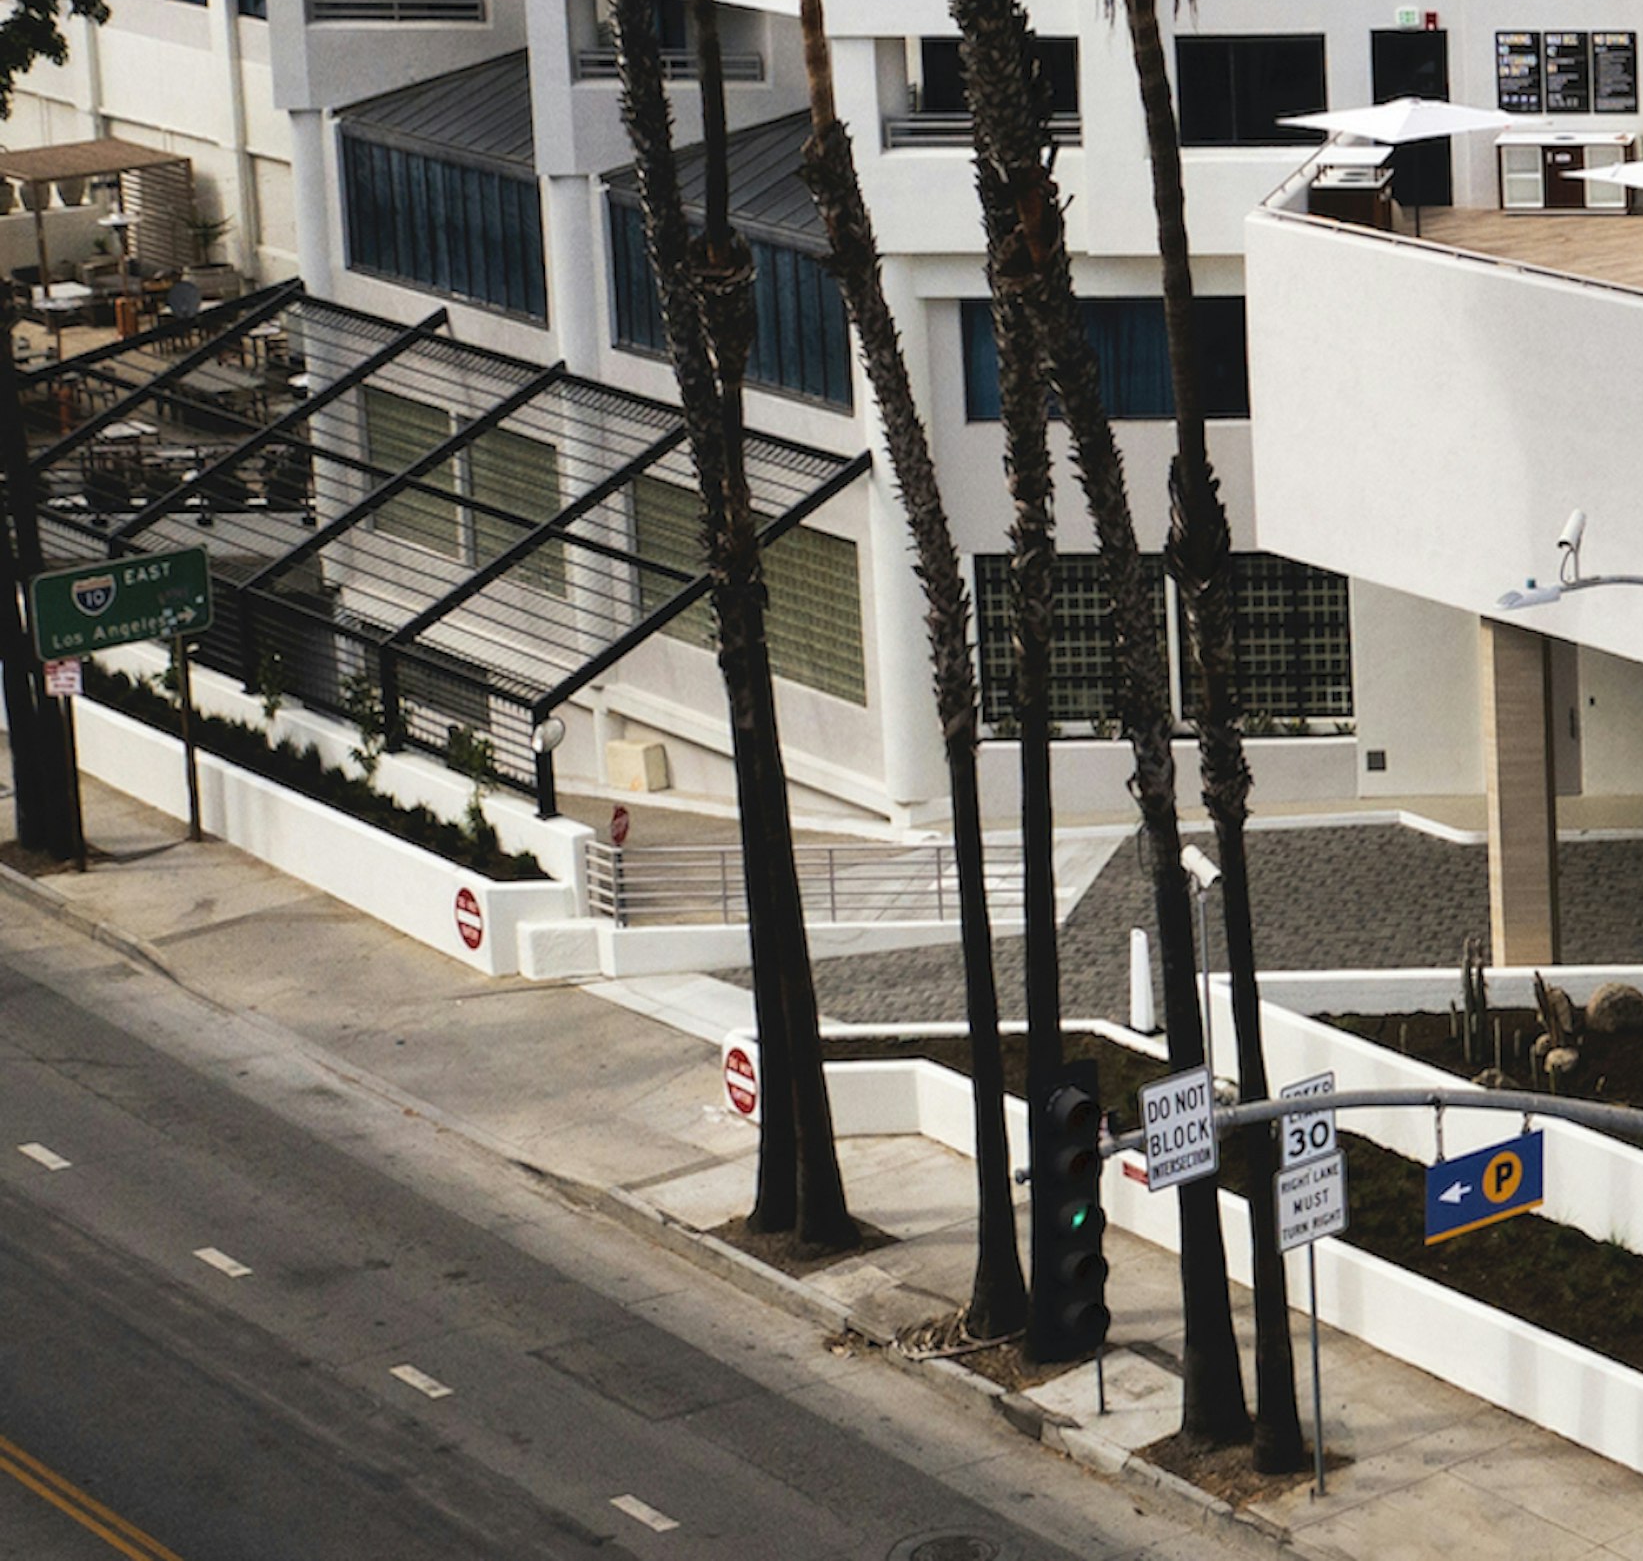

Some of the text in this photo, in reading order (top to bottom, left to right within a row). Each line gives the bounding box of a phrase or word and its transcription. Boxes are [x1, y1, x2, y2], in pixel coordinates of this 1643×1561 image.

[123, 562, 171, 586] EAST
[85, 589, 106, 607] 10
[52, 616, 167, 650] Los Angeles
[1148, 1083, 1205, 1123] DO NOT
[1150, 1117, 1209, 1157] BLOCK
[1288, 1120, 1329, 1157] 30
[1153, 1147, 1211, 1178] INTERSECTION
[1496, 1161, 1515, 1192] P
[1281, 1163, 1339, 1194] RIGHT LANE
[1294, 1187, 1329, 1215] MUST
[1283, 1208, 1341, 1240] TURN RIGHT
